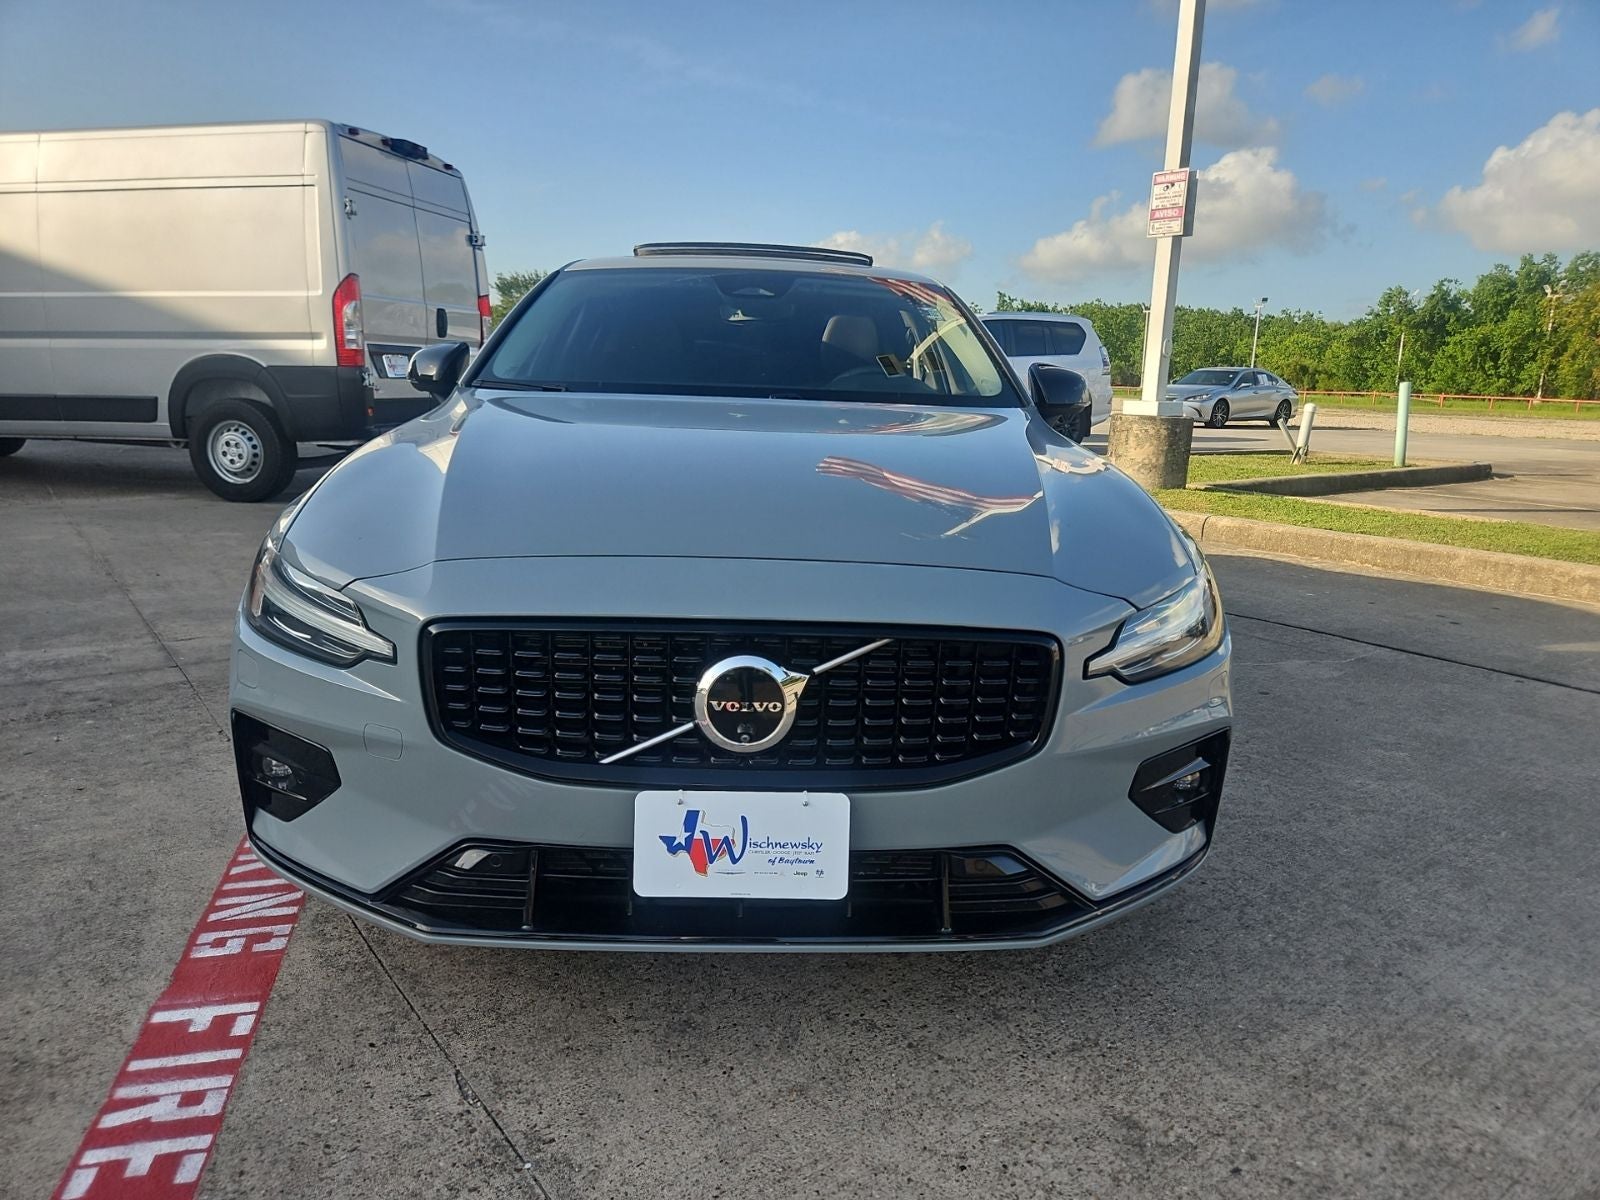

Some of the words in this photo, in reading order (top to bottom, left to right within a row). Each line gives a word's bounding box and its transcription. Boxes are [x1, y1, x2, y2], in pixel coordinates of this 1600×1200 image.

[1153, 208, 1179, 218] AVISO
[709, 700, 783, 713] VOLVO
[768, 857, 777, 866] of
[778, 857, 815, 866] Baytown
[62, 1001, 260, 1200] FIRE
